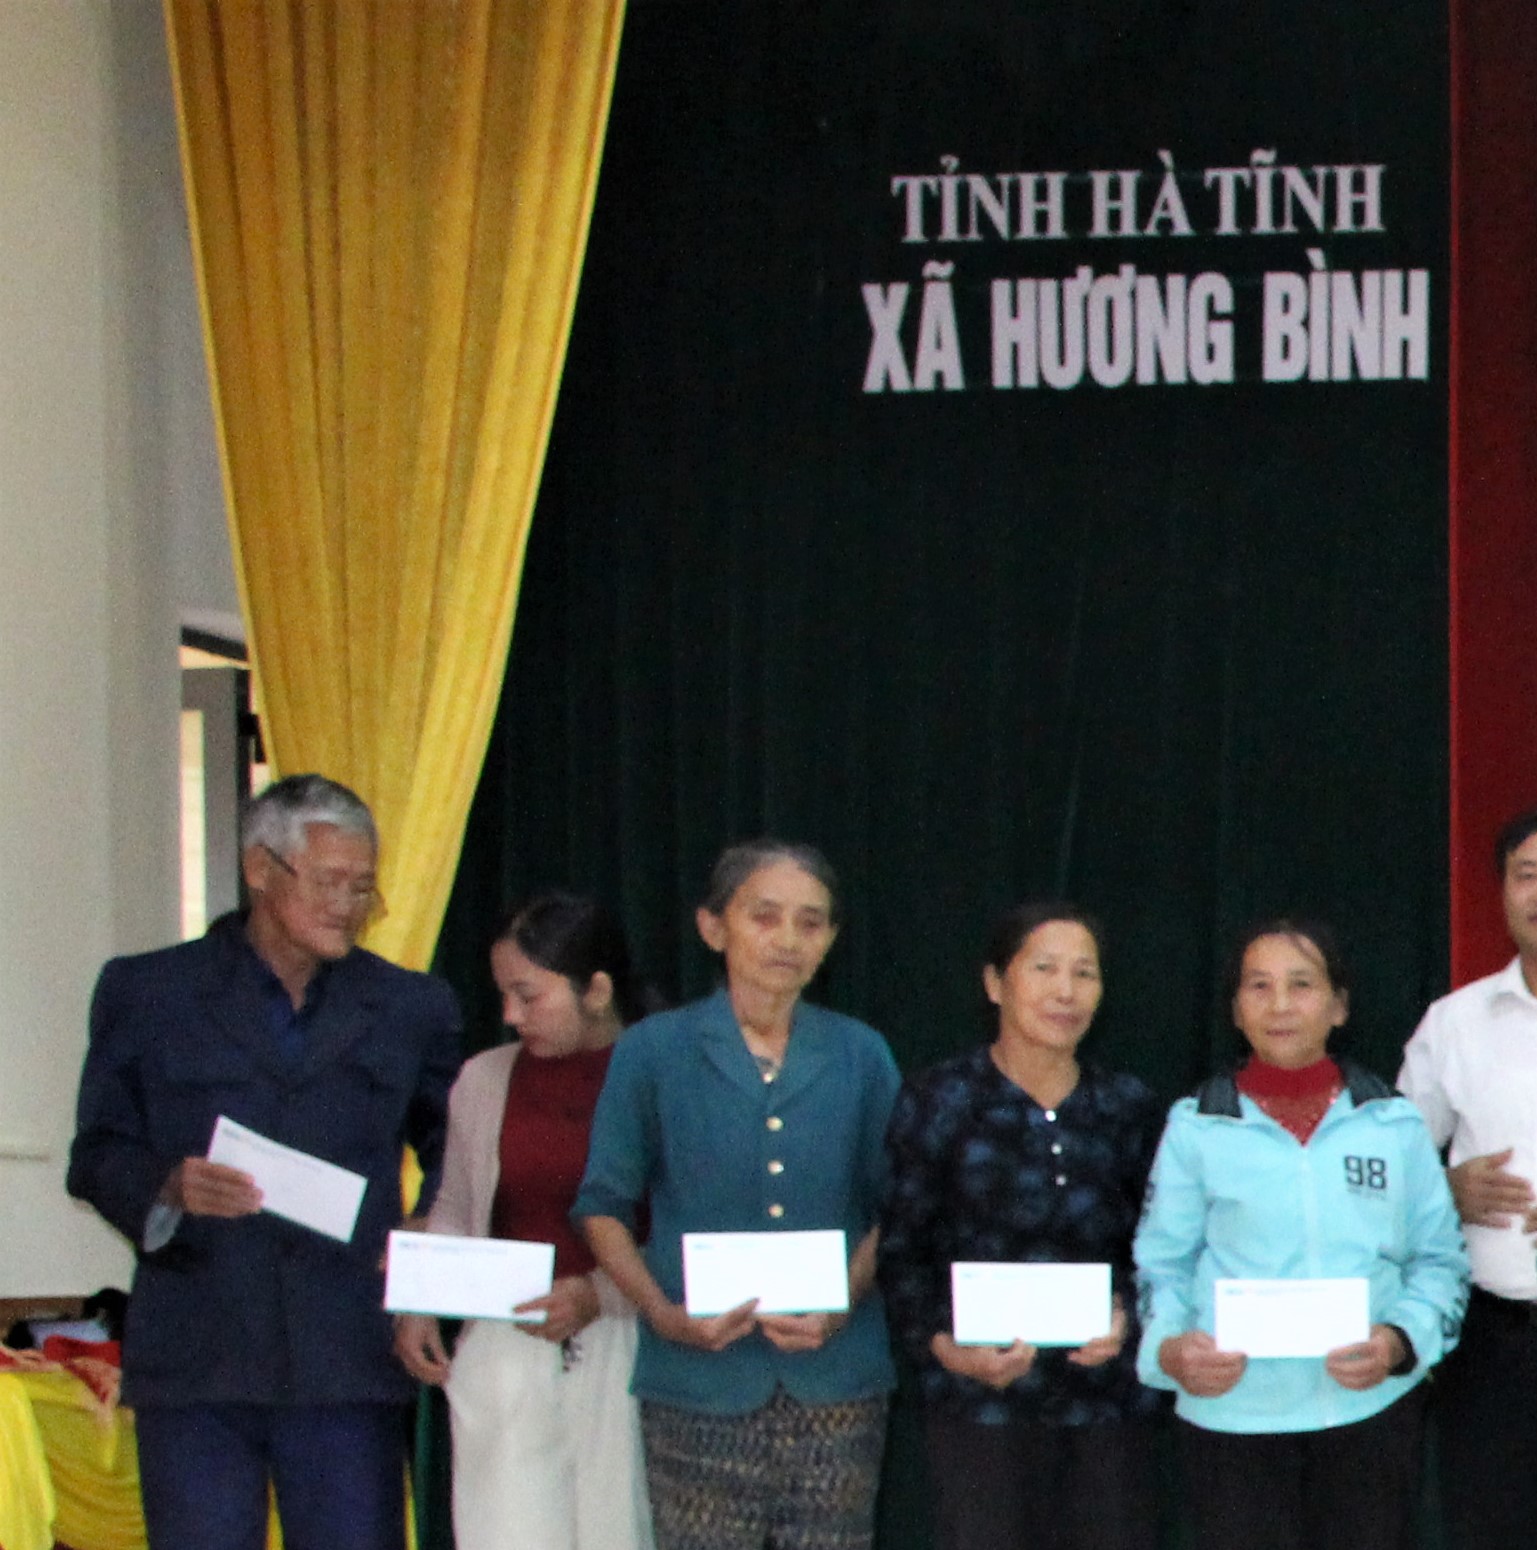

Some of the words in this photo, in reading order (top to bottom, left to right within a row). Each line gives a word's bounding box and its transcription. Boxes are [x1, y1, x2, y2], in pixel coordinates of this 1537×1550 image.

[891, 154, 1067, 243] TỈNH
[1088, 149, 1195, 238] HÀ
[1204, 147, 1386, 236] TĨNH
[861, 260, 965, 394] XÃ
[991, 263, 1235, 390] HƯƠNG
[1262, 247, 1430, 383] BÌNH
[1343, 1154, 1388, 1190] 98
